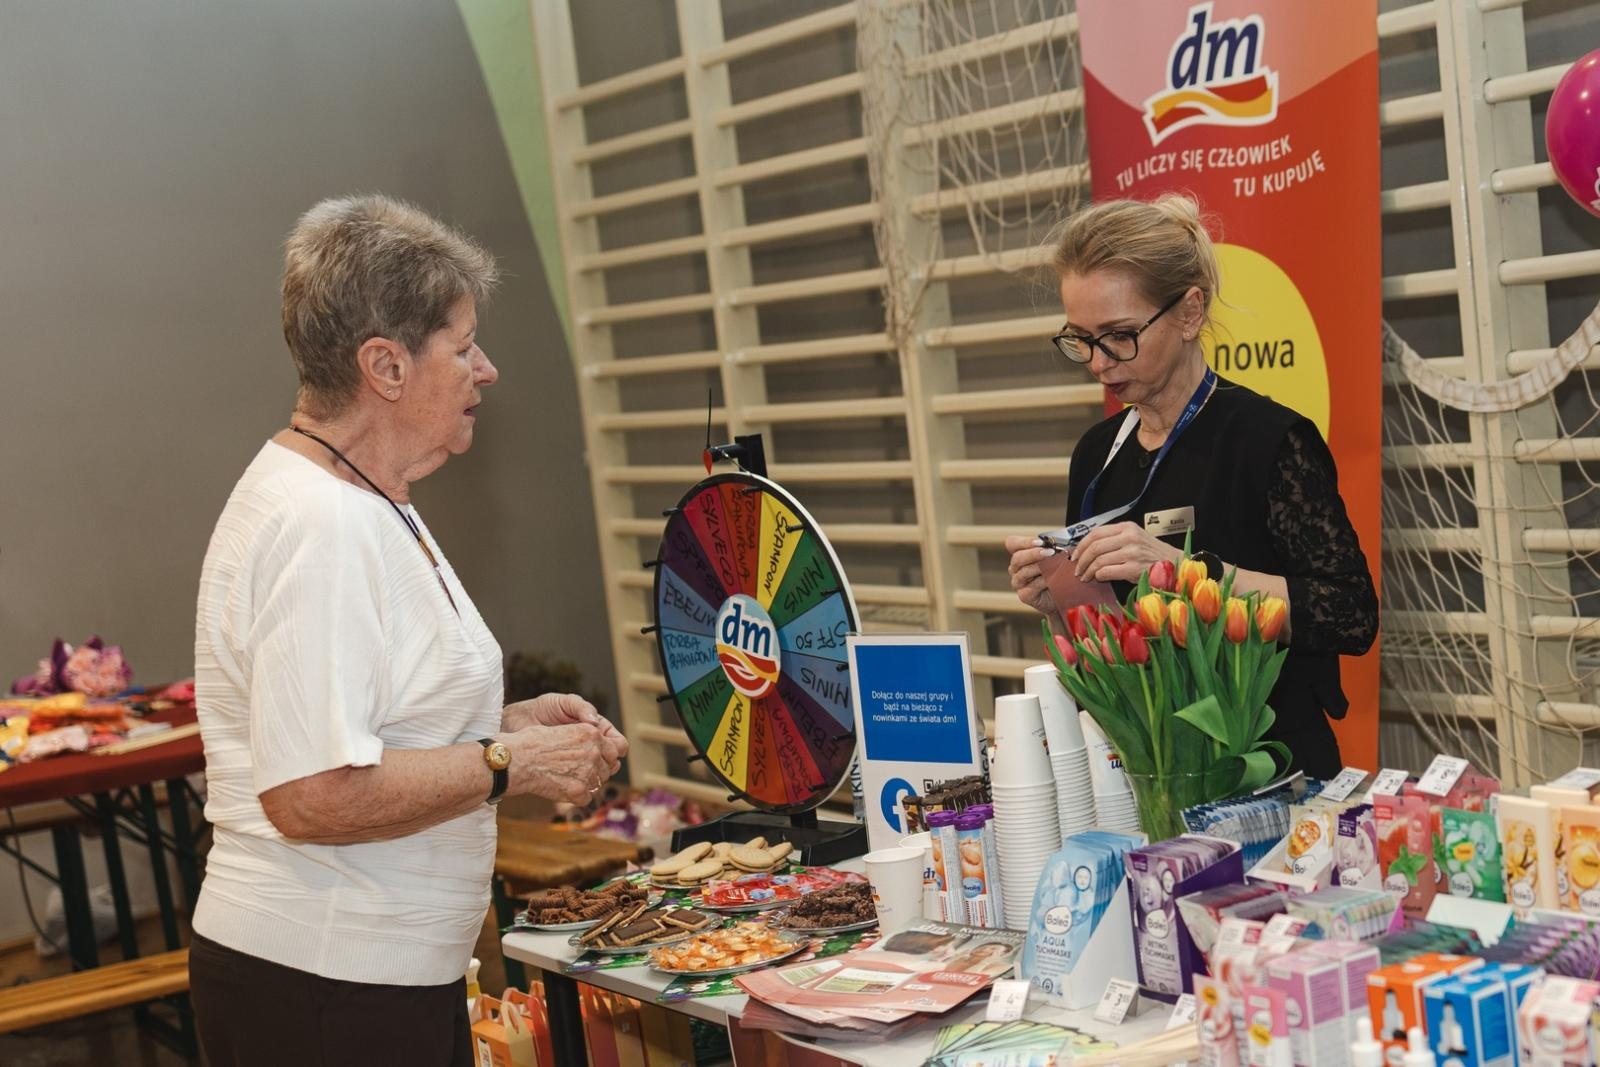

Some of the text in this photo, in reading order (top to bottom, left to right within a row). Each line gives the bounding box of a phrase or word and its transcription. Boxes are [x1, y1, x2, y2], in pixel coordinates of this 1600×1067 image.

[1171, 10, 1259, 90] dm
[1115, 134, 1292, 191] TU LICZY SIĘ CZŁOWIEK
[1233, 150, 1326, 197] TU KUPUJĘ
[1214, 339, 1295, 372] nowa
[764, 511, 790, 596] SZAMPON
[783, 555, 825, 613] MINIS
[722, 602, 771, 658] dm
[796, 631, 813, 650] 50
[687, 674, 728, 722] MINIS
[800, 667, 849, 708] MINIS
[871, 690, 893, 701] Dołącz
[895, 691, 904, 700] do
[905, 692, 928, 701] naszej
[928, 692, 949, 702] grupy
[911, 703, 937, 713] bieżąco
[720, 694, 744, 777] SZAMPON
[872, 714, 908, 722] nowinkami
[919, 714, 941, 723] świata
[942, 714, 957, 723] dm!
[1042, 936, 1066, 947] AQUA
[1046, 914, 1069, 928] Balea
[1035, 944, 1072, 959] TUCHMASKE
